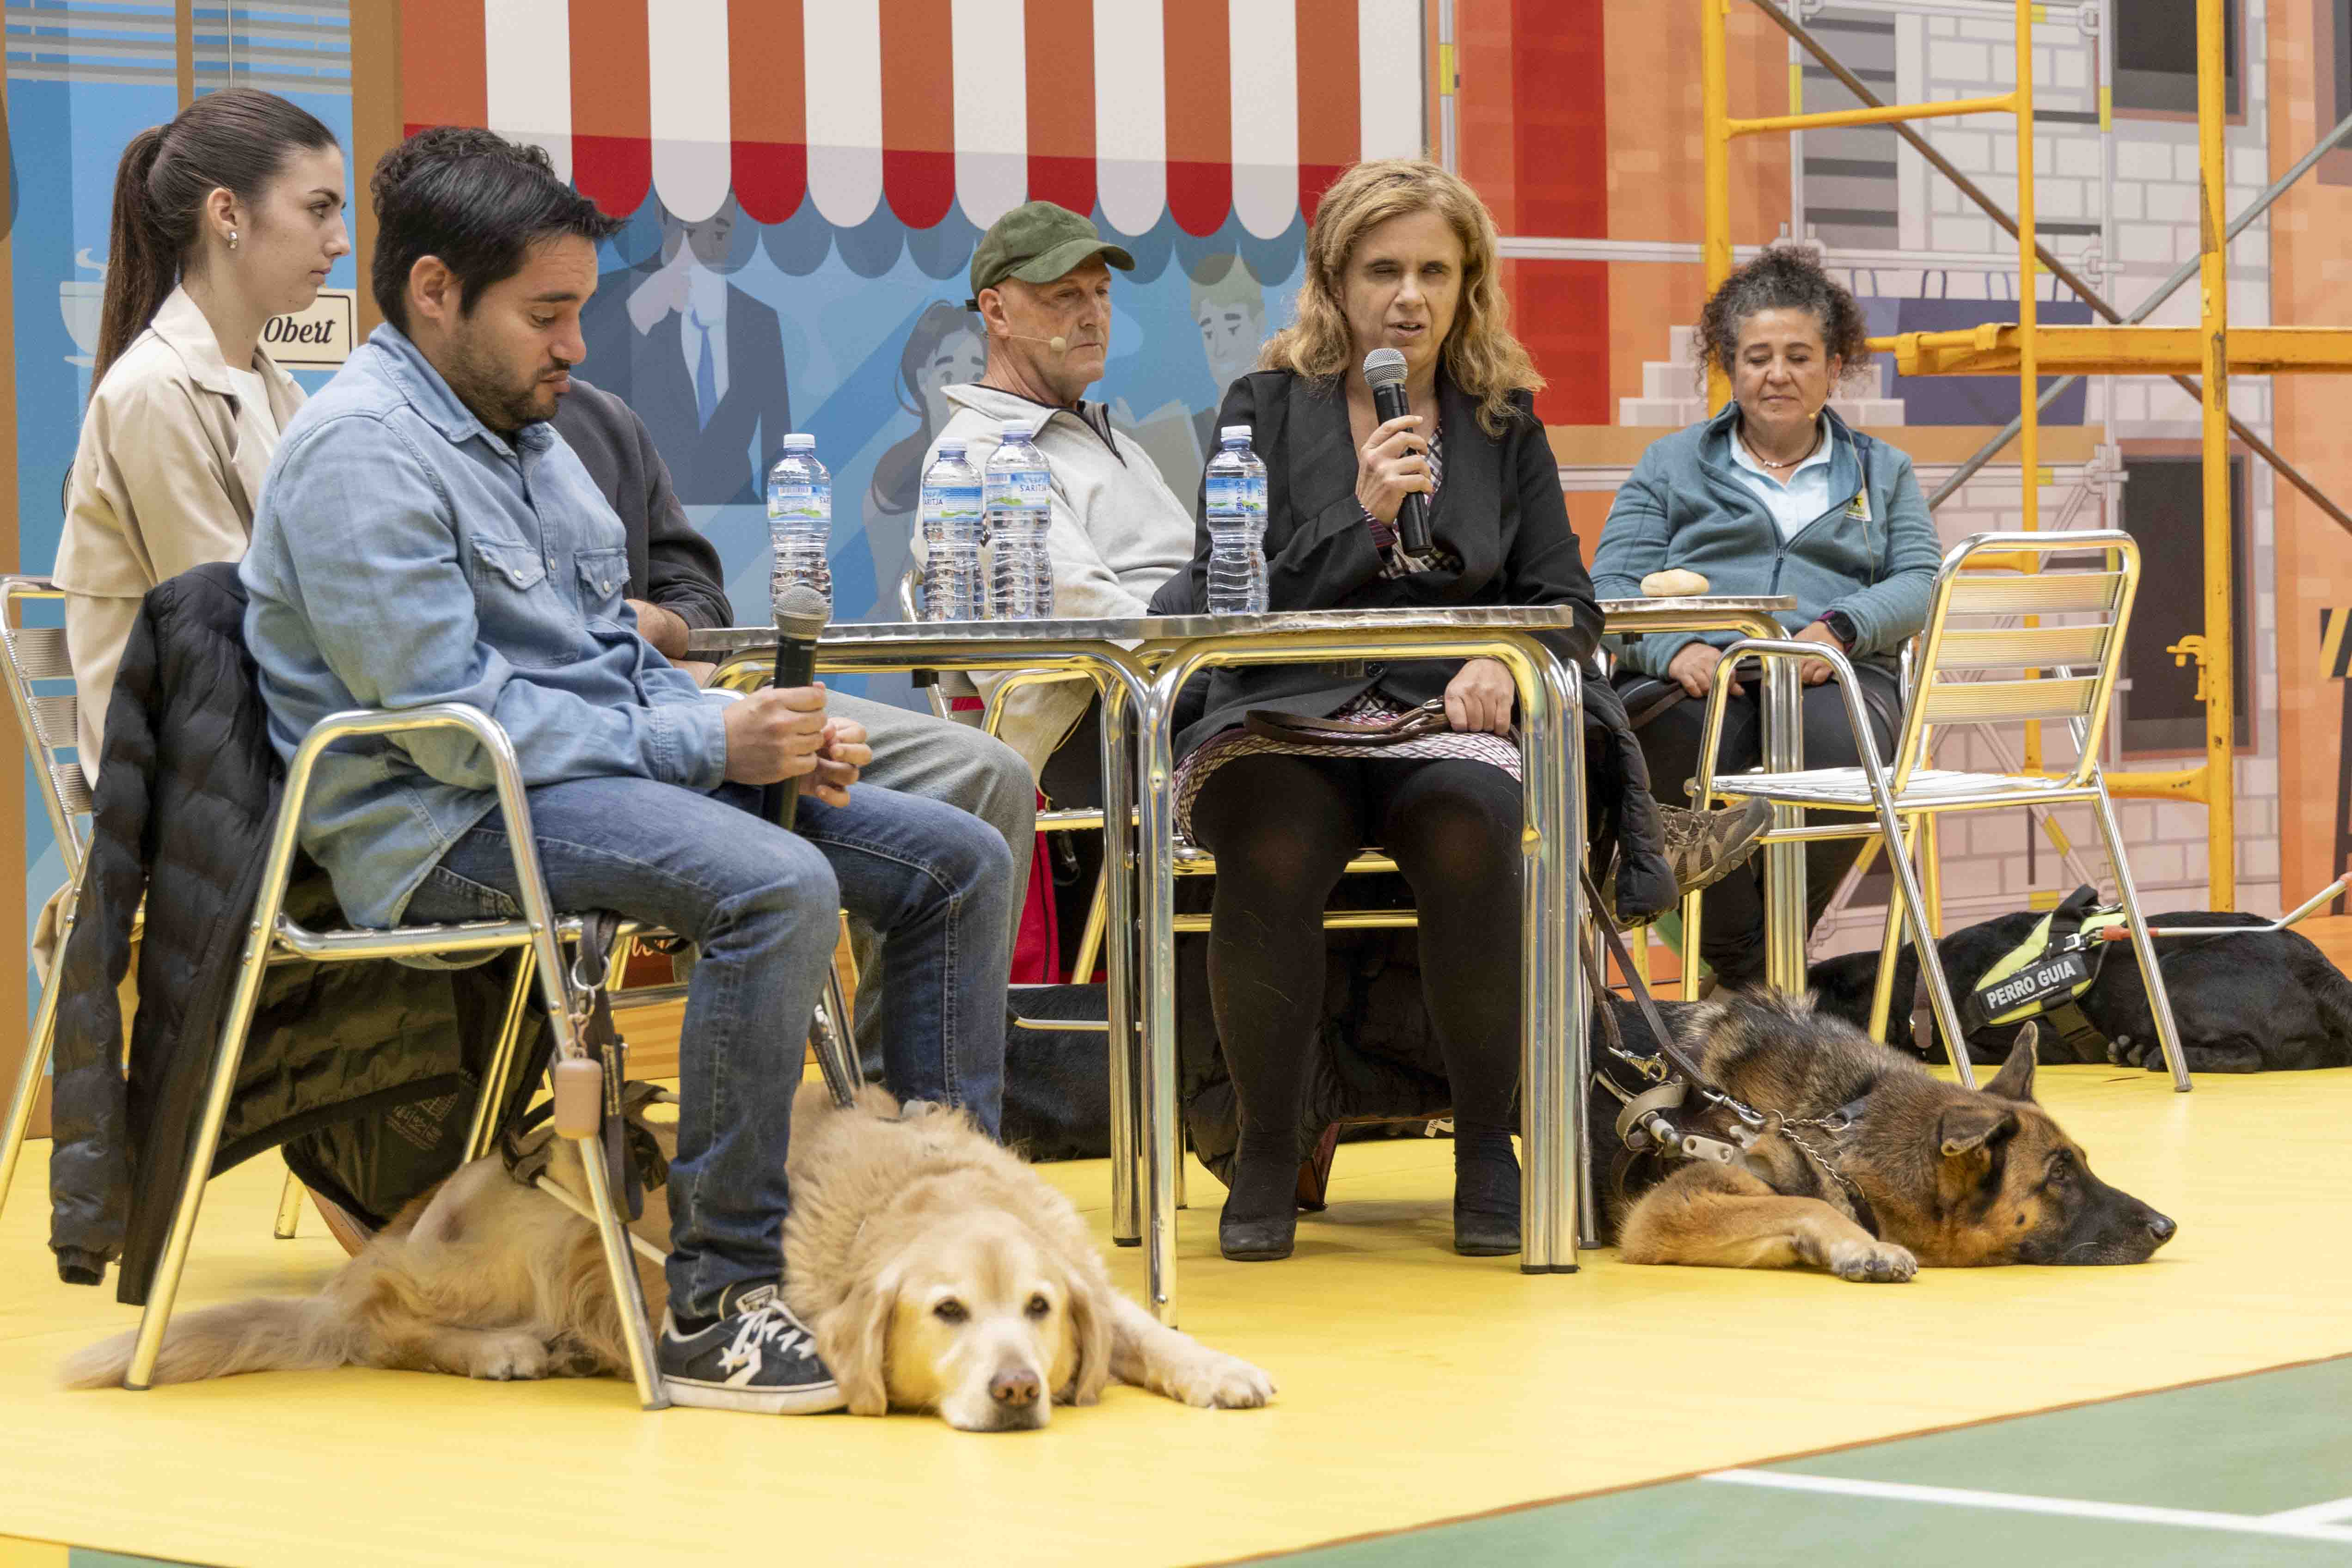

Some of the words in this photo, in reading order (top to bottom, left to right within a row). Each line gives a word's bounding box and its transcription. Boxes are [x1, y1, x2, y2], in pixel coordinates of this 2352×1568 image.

[264, 316, 336, 343] Obert
[1986, 976, 2036, 1009] PERRO
[2038, 961, 2076, 986] GUIA
